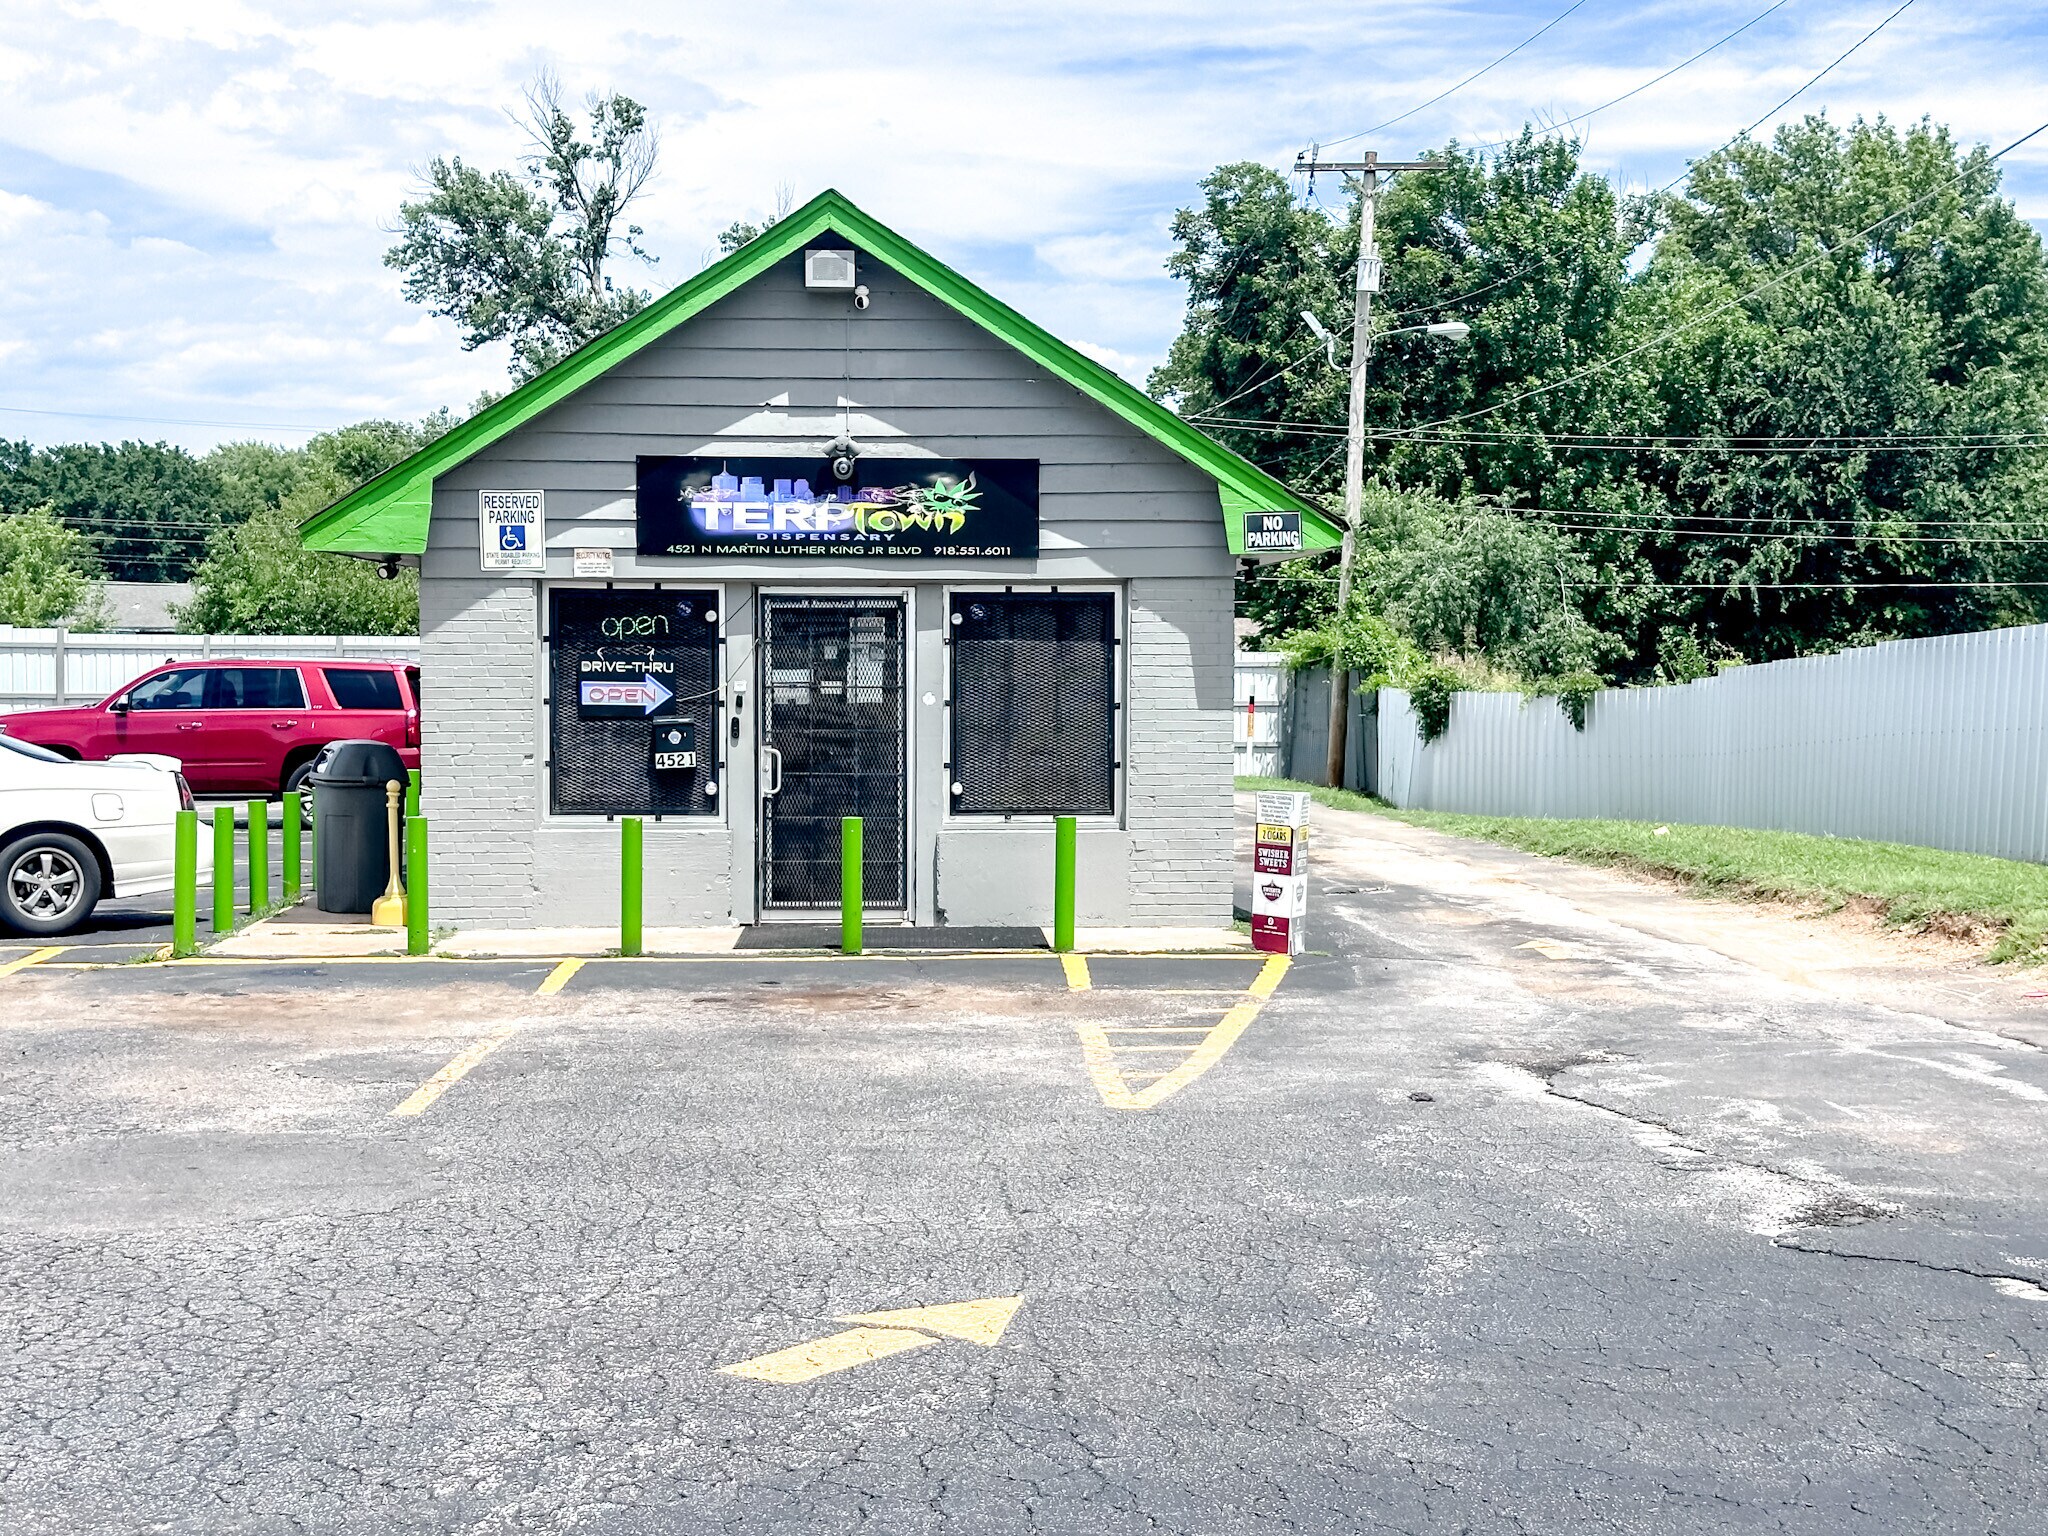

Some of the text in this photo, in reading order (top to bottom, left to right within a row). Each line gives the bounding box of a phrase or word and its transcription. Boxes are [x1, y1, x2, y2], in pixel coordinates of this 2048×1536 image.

[484, 495, 540, 509] RESERVED
[488, 510, 535, 524] PARKING
[1262, 516, 1284, 531] NO
[756, 533, 896, 542] DISPENSARY
[1247, 531, 1300, 547] PARKING
[595, 551, 611, 560] NOTICE
[666, 544, 1012, 556] 4521 N MARTIN LUTHER KING JR BLVD 918.551.6011
[601, 614, 669, 641] open
[580, 660, 674, 673] DRIVE-THRU
[589, 687, 656, 703] OPEN
[656, 753, 696, 768] 4521
[1267, 830, 1287, 841] CIGARS
[1258, 847, 1289, 859] SWISHER
[1259, 856, 1288, 868] SWEETS
